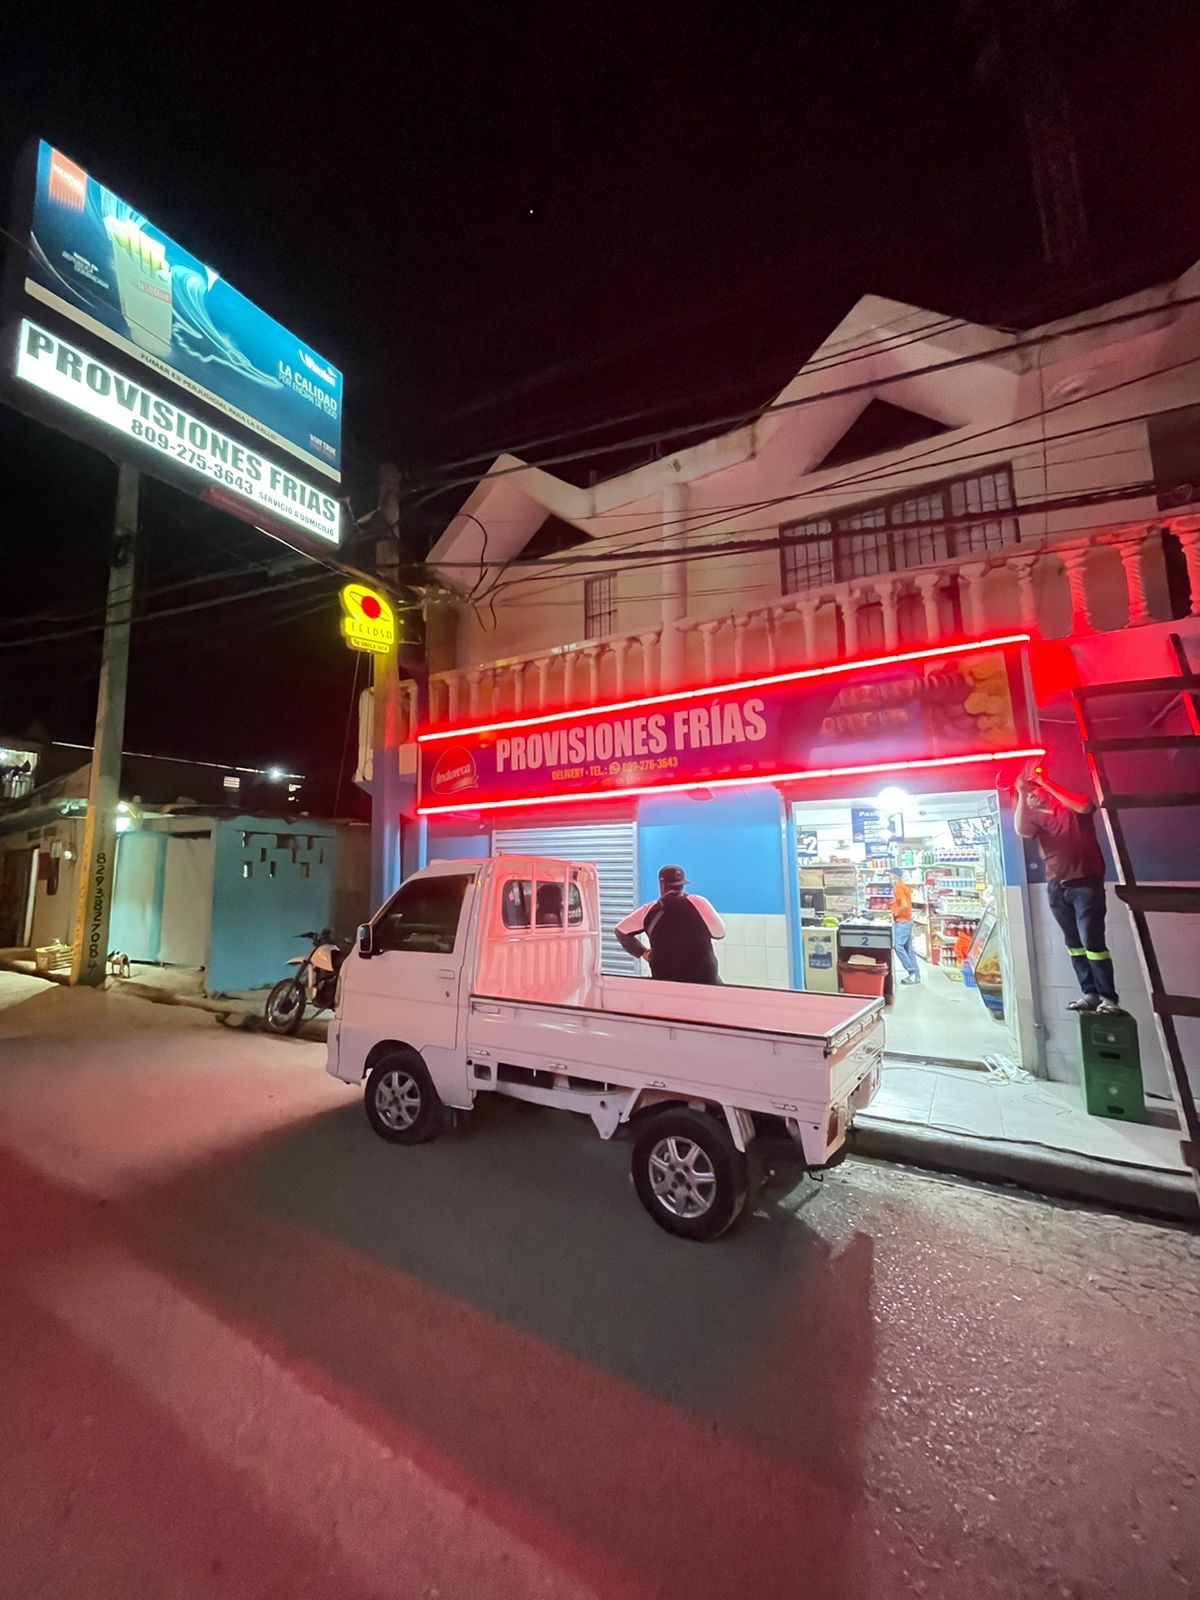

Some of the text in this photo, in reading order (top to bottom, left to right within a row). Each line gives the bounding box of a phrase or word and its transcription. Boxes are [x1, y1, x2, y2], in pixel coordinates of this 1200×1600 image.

[140, 352, 171, 376] FUMAR
[279, 360, 337, 411] LA CALIDAD
[26, 326, 336, 523] PROVISIONES FRIAS
[131, 419, 253, 495] 809-275-3643
[259, 491, 293, 515] SERVICIO
[300, 514, 334, 537] DOMICILIO
[495, 698, 767, 772] PROVISIONES FRÍAS
[552, 767, 584, 781] DELIVERY
[861, 936, 869, 946] 2
